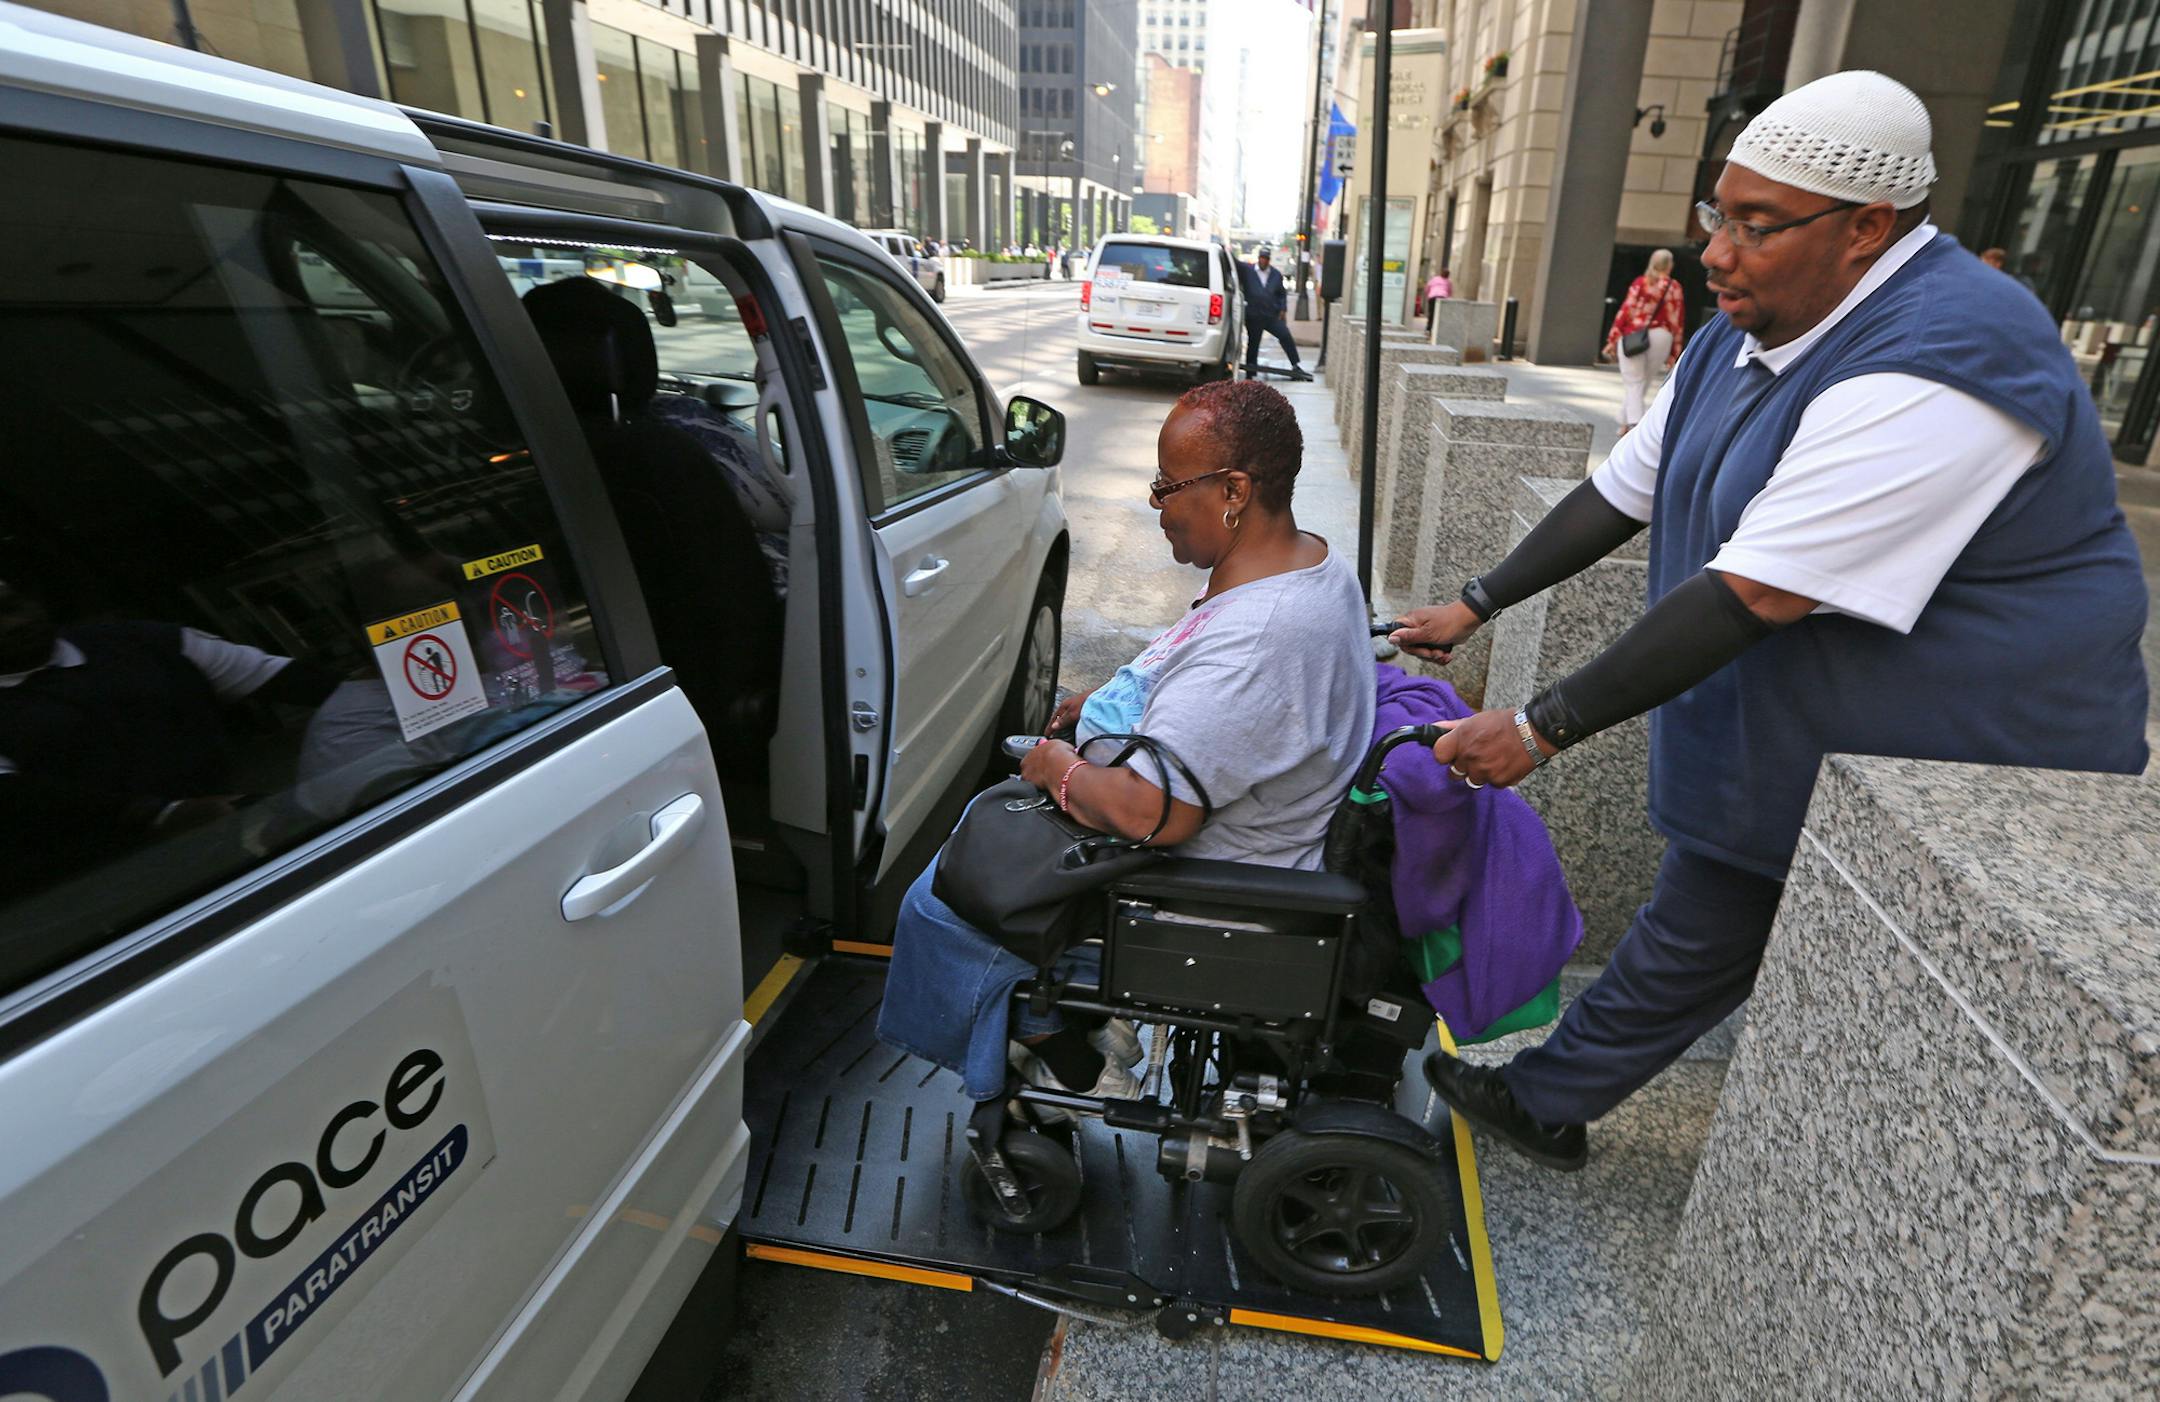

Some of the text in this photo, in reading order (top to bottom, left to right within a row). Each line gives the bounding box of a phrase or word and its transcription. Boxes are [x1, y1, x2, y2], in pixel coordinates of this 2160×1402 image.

[487, 547, 537, 571] CAUTION
[400, 607, 449, 633] CAUTION
[138, 1049, 445, 1378] pace
[263, 1140, 456, 1344] PARATRANSIT
